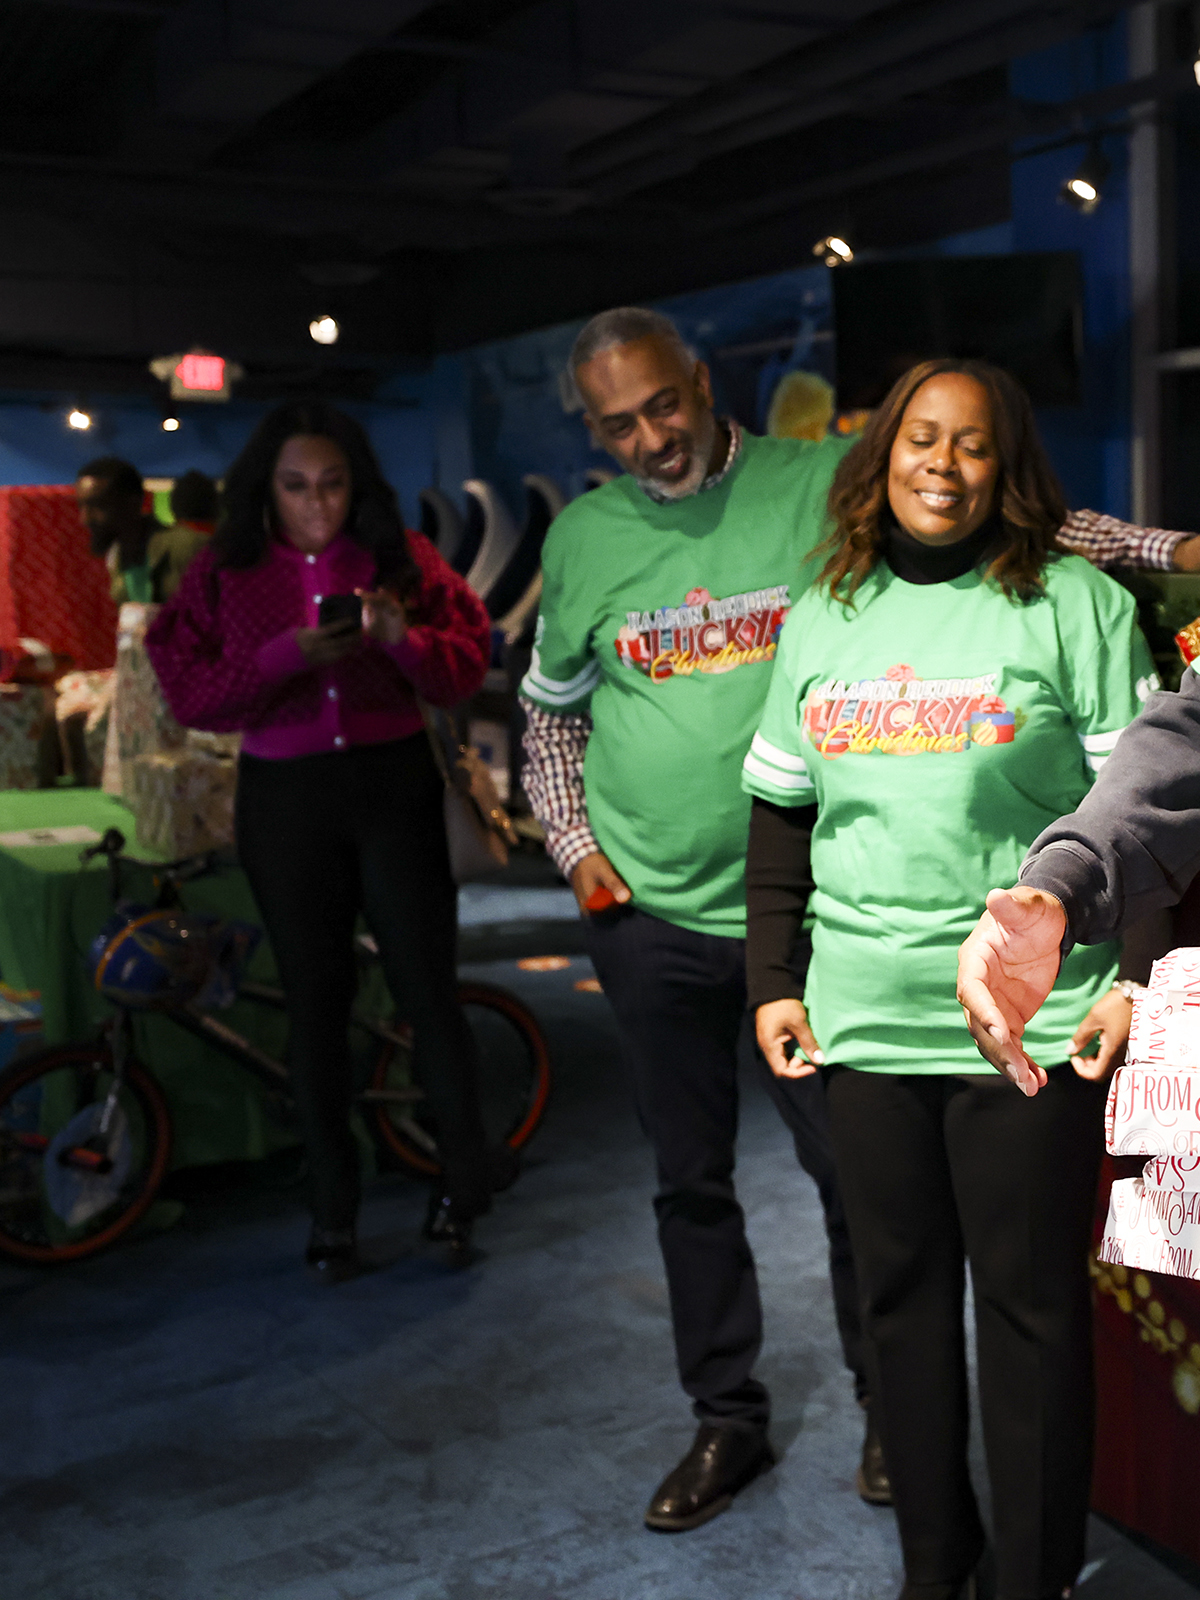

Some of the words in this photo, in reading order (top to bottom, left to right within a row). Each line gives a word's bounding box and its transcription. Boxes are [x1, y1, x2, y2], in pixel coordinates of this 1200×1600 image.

[649, 608, 774, 671] LUCKY
[826, 696, 974, 742] LUCKY
[1117, 1070, 1191, 1127] FROM
